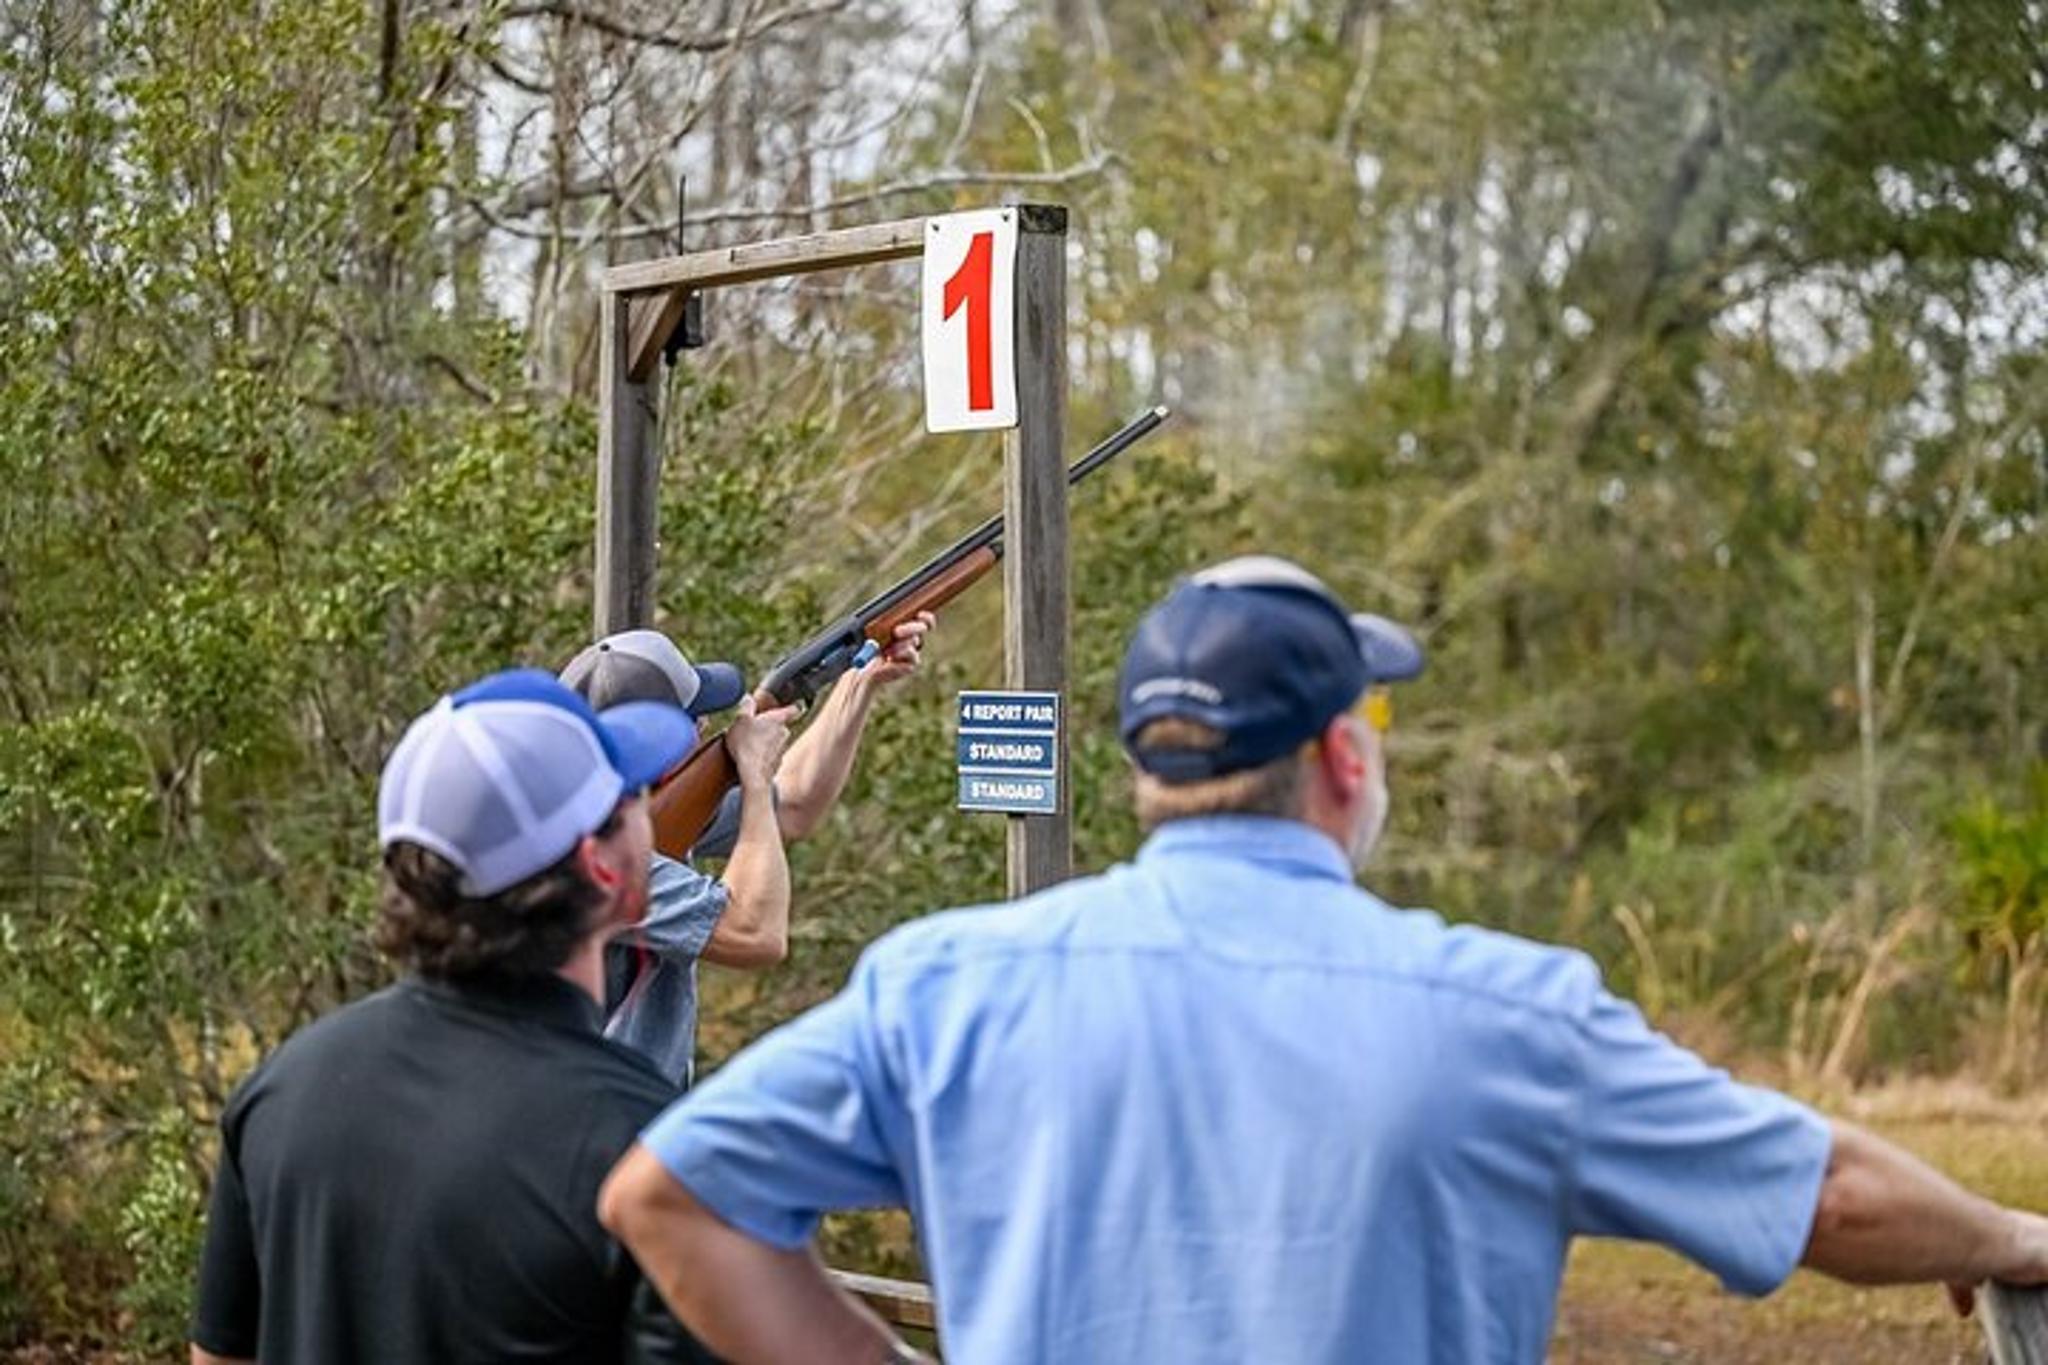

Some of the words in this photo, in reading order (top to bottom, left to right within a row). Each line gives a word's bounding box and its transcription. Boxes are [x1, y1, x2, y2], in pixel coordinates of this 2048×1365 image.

[943, 231, 993, 411] 1
[961, 703, 971, 720] 4
[973, 704, 1022, 720] REPORT
[1024, 705, 1053, 721] PAIR
[969, 742, 1044, 761] STANDARD
[971, 781, 1045, 800] STANDARD
